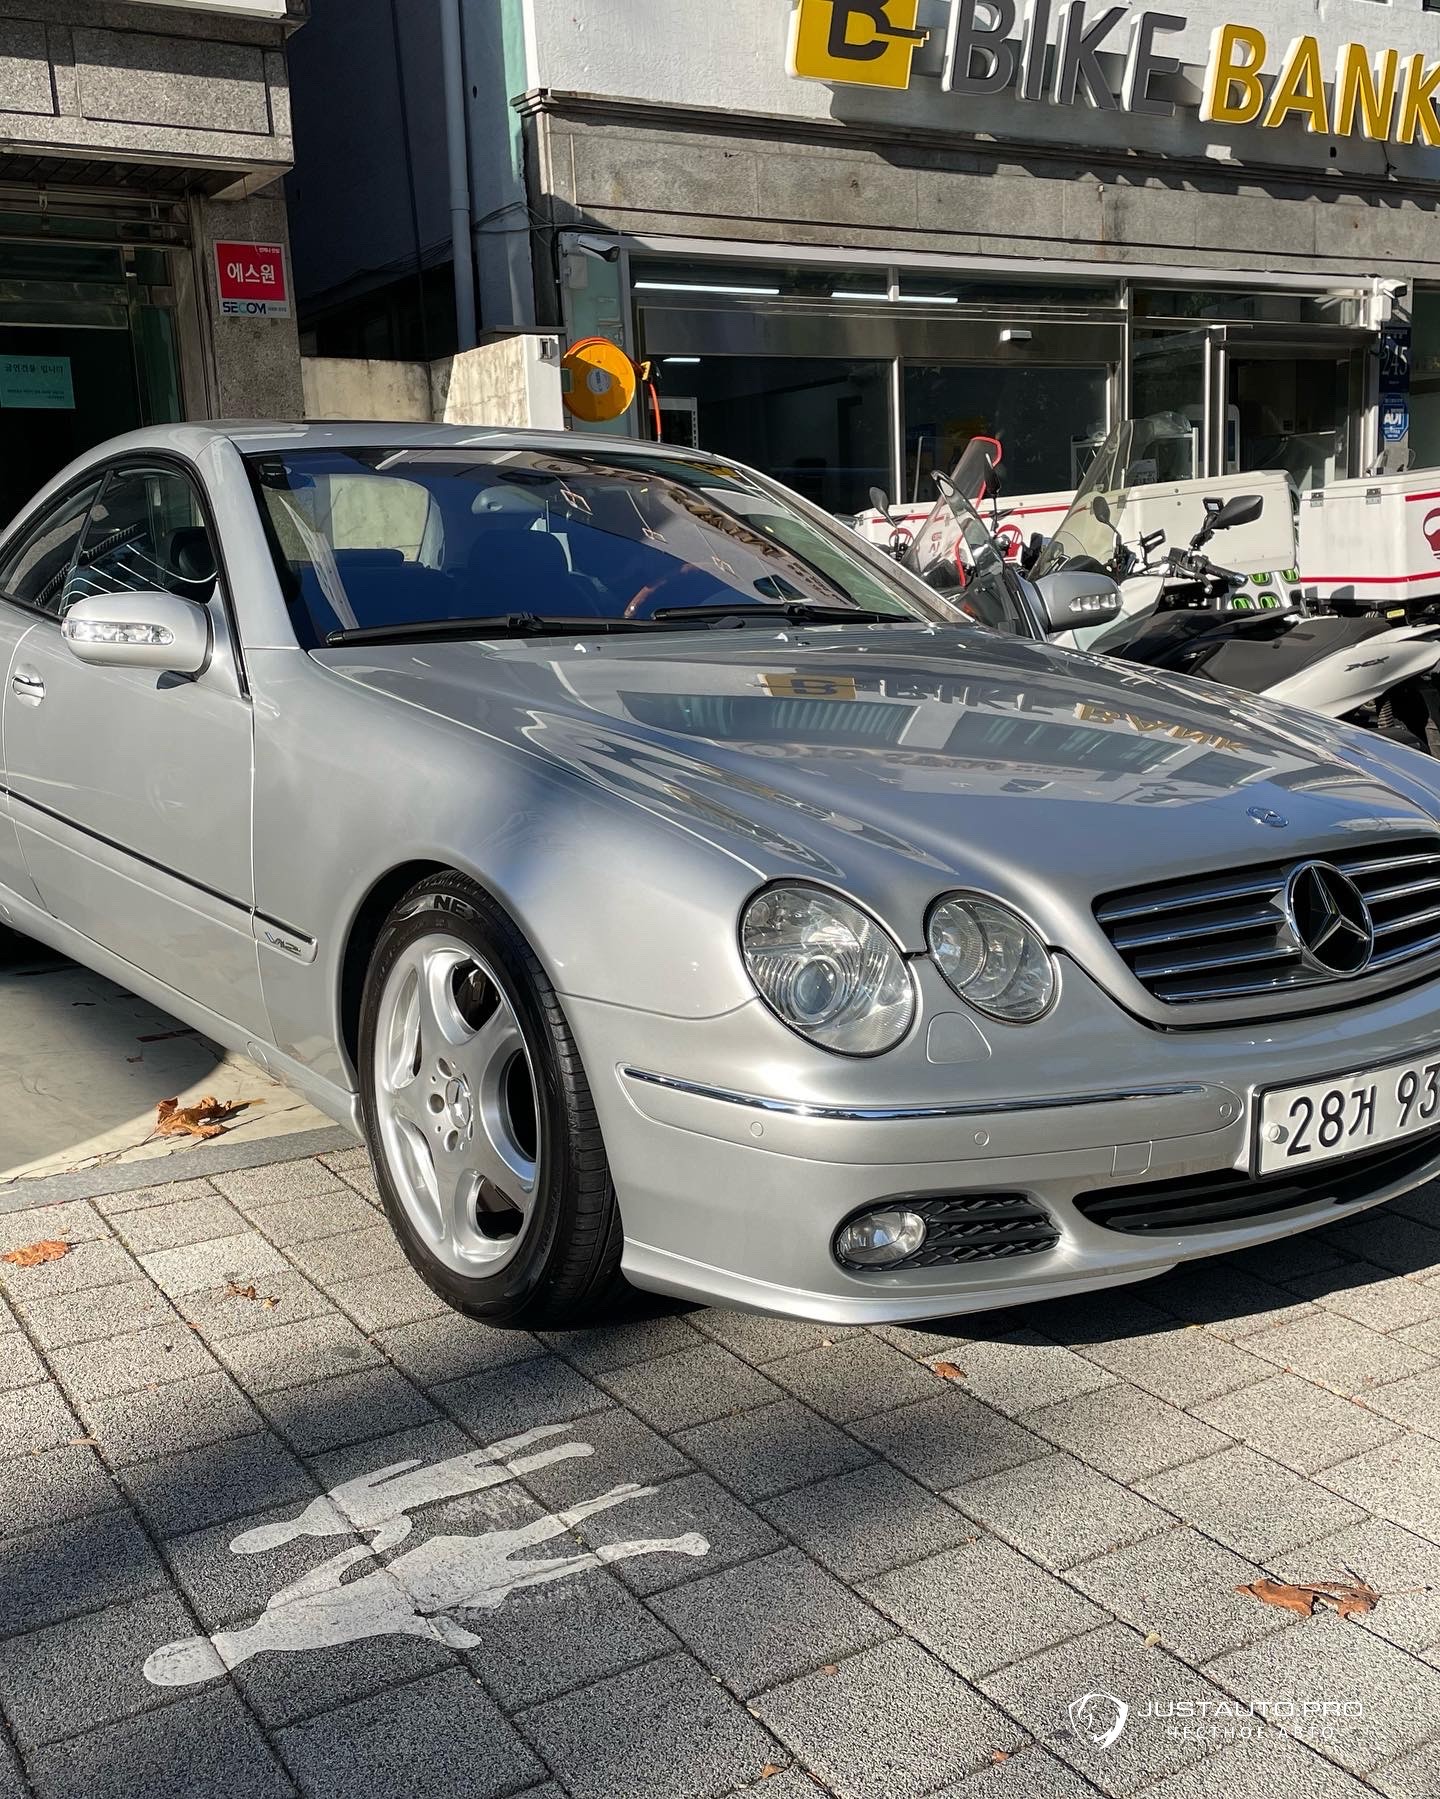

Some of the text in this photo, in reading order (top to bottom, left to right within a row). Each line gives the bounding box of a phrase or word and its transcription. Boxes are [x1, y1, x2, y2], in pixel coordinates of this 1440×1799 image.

[942, 0, 1440, 148] BIKE BANK
[227, 262, 276, 285] 에스원
[222, 301, 267, 315] SECOM
[1381, 345, 1408, 376] 245
[1286, 1063, 1440, 1158] 28거 93
